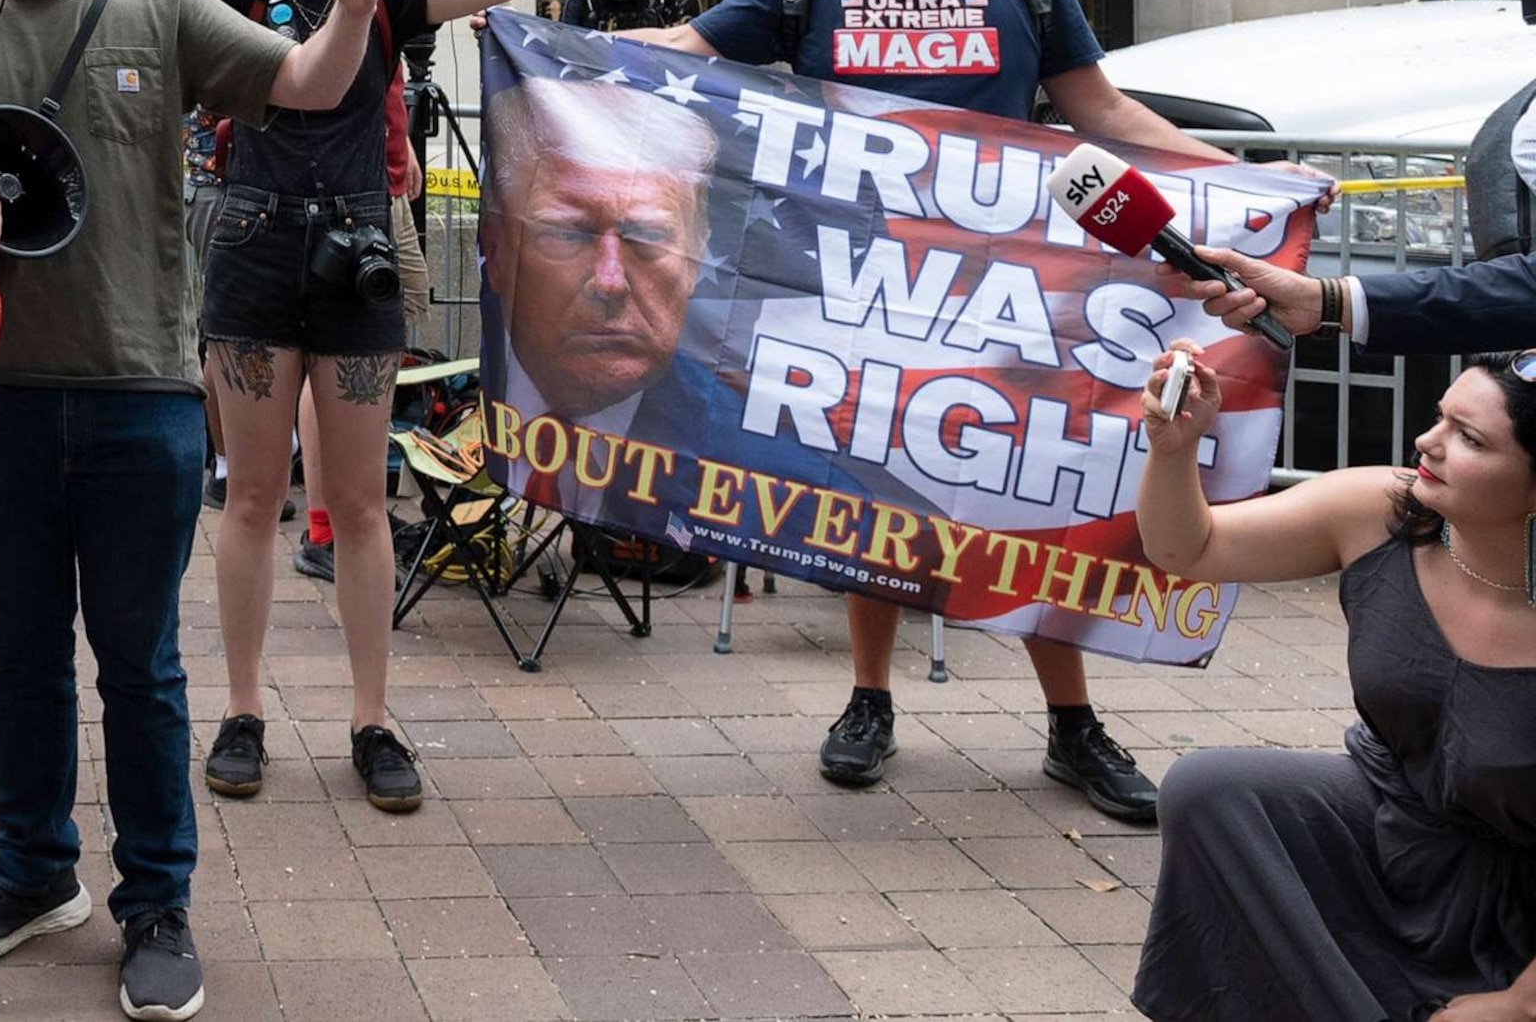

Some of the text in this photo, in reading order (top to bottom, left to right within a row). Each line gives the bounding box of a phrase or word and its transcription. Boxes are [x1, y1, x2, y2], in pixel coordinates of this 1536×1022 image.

[844, 8, 985, 28] EXTREME
[836, 33, 997, 68] MAGA
[1065, 164, 1107, 207] sky
[1091, 190, 1133, 227] tg24
[817, 225, 1175, 391] WAS
[479, 389, 1221, 640] BOUT EVERYTHING
[693, 524, 922, 594] www.TrumpSwag.com
